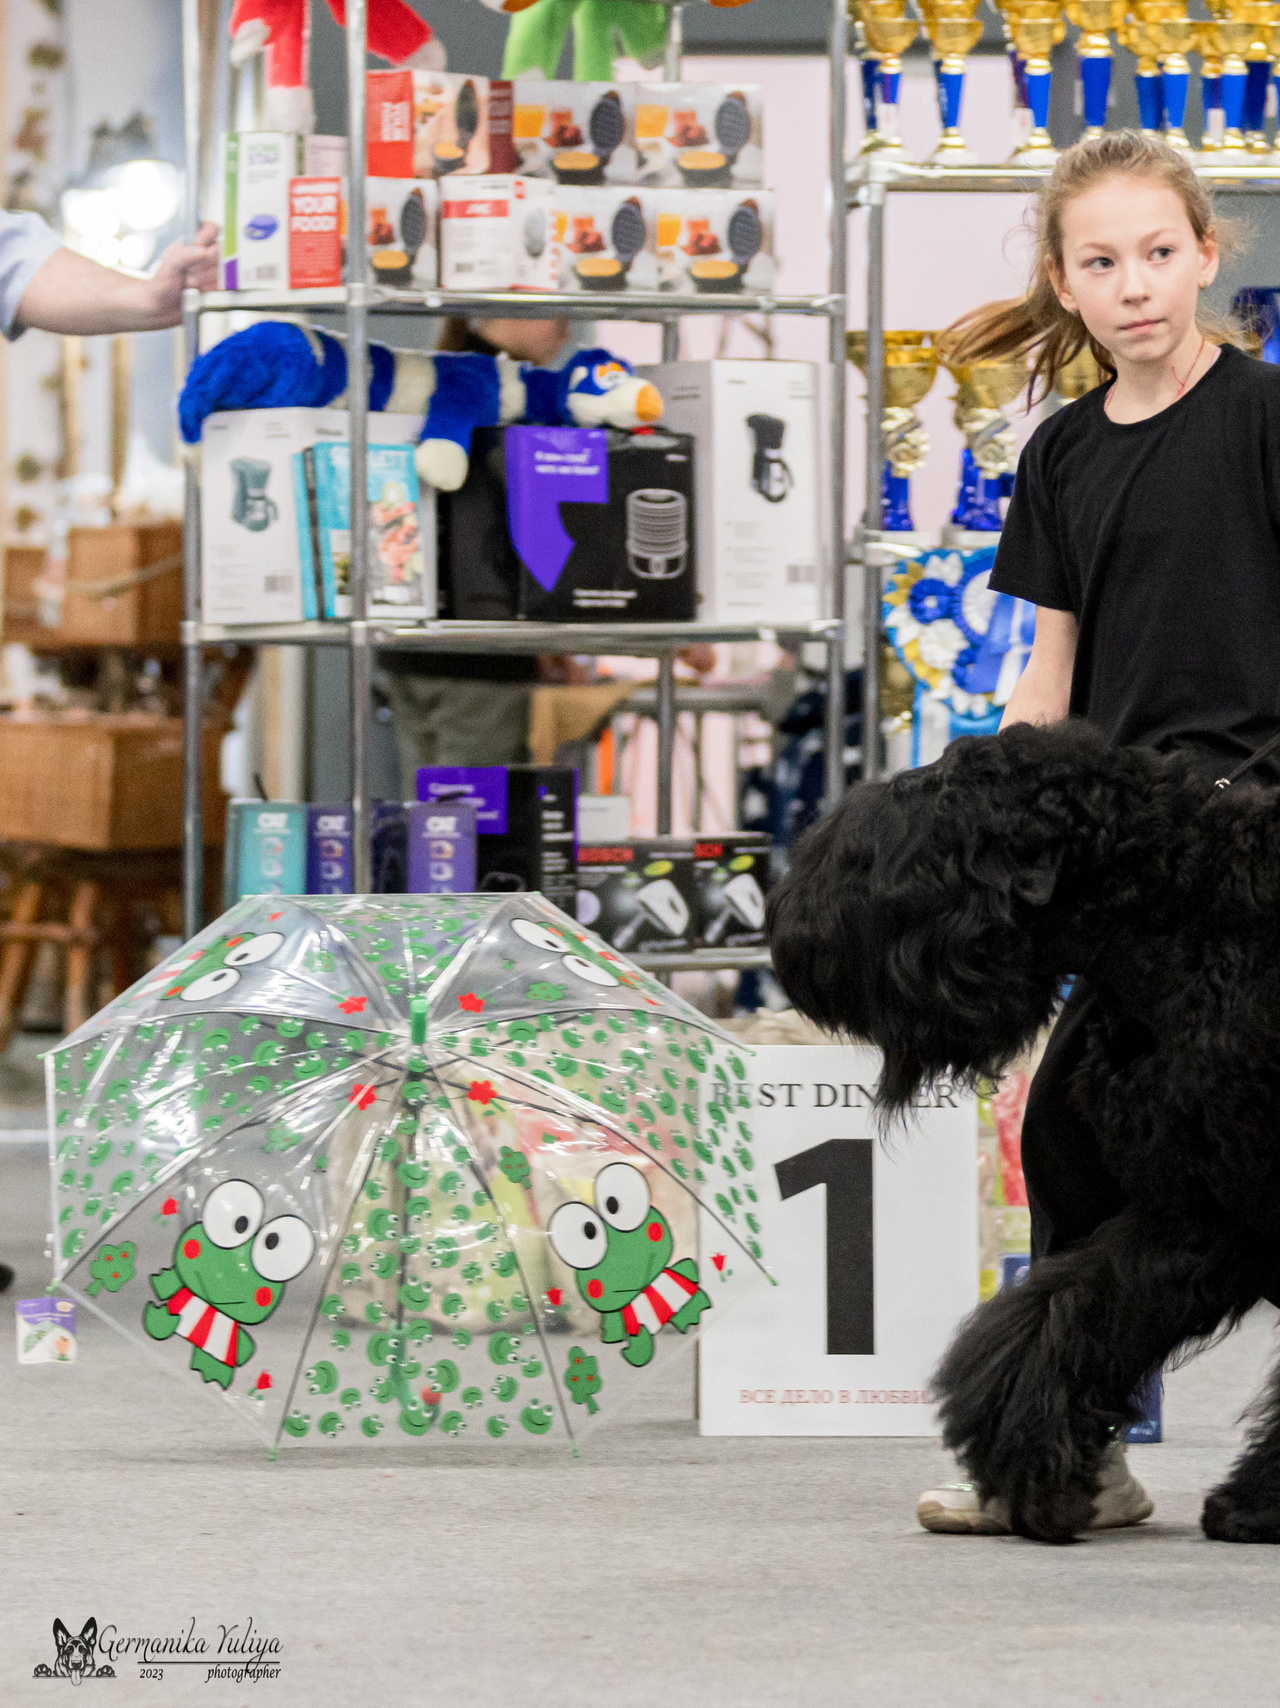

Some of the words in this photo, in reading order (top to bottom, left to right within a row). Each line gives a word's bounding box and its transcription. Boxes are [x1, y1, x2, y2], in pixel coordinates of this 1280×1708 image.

[774, 1138, 875, 1355] 1
[739, 1389, 776, 1404] ВСЕ
[779, 1389, 834, 1406] ДЕЛО
[839, 1389, 850, 1404] В
